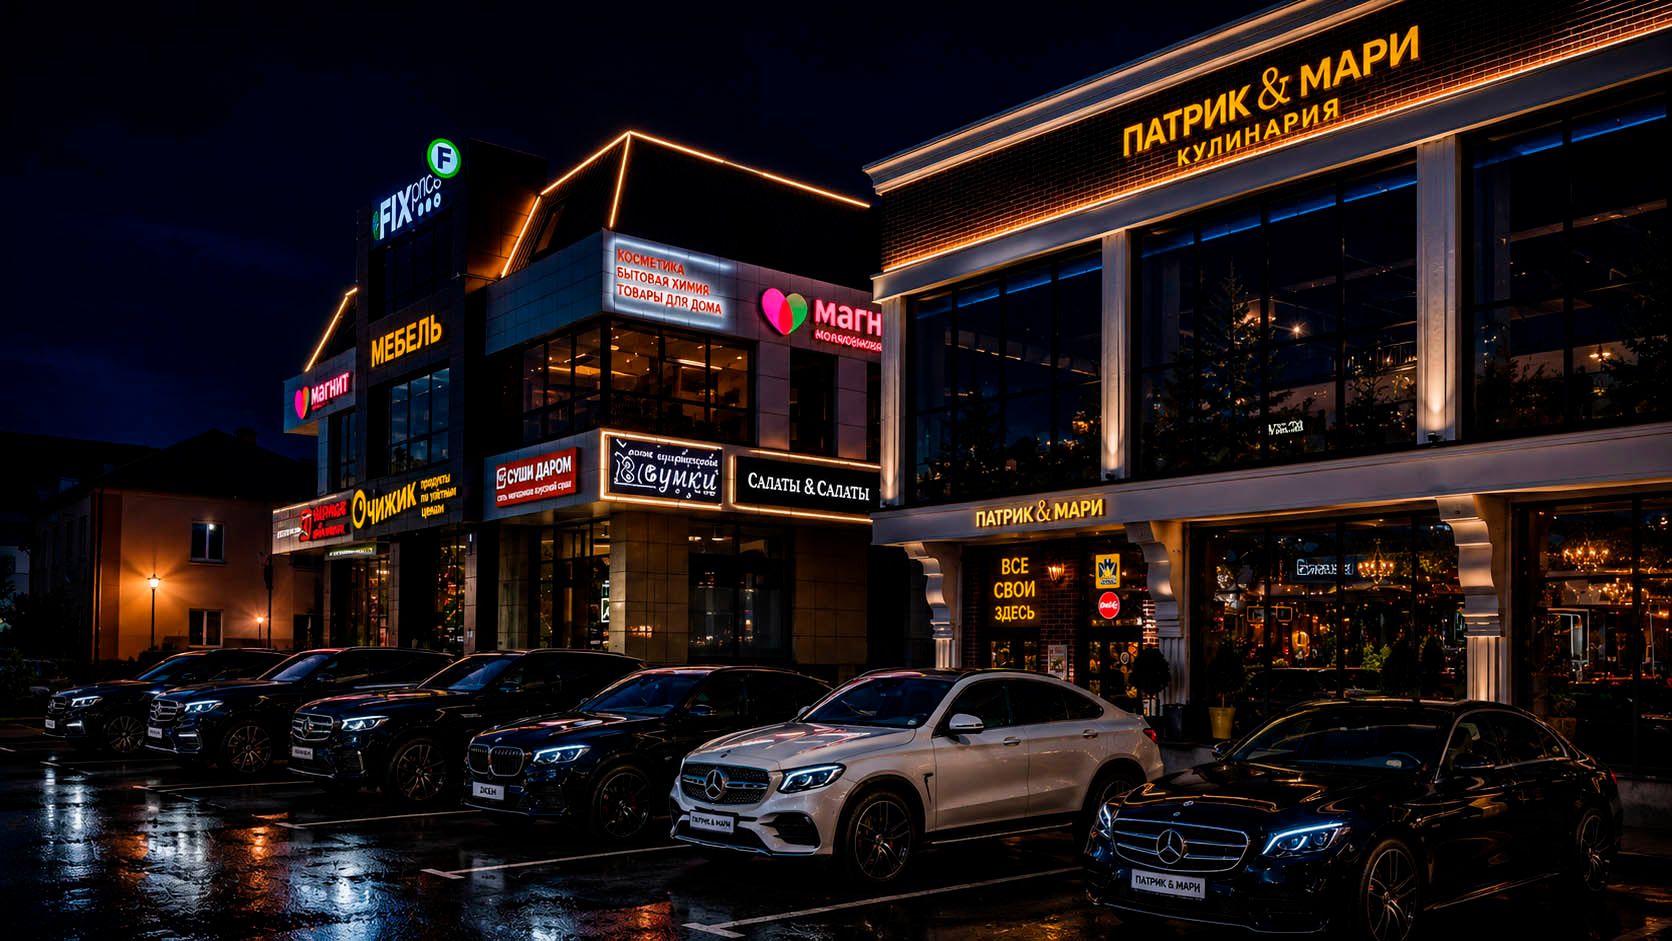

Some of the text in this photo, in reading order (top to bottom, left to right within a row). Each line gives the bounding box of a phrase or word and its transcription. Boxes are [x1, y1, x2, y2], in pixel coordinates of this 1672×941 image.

[1122, 25, 1420, 157] ПАТРИК & МАРИ
[1177, 97, 1340, 167] КУЛИНАРИЯ
[437, 145, 452, 169] F
[380, 184, 413, 240] FIX
[617, 248, 685, 275] КОСМЕТИКА
[617, 267, 710, 296] БЫТОВАЯ ХИМИЯ
[617, 284, 722, 315] ТОВАРЫ ДЛЯ ДОМА
[371, 313, 443, 368] МЕБЕЛЬ
[507, 455, 572, 485] СУШИ ДАРОМ
[804, 477, 816, 495] &
[976, 498, 1103, 528] ПАТРИК & МАРИ
[1001, 556, 1030, 576] ВСЕ
[993, 579, 1036, 599] СВОИ
[994, 604, 1036, 623] ЗДЕСЬ
[1136, 875, 1167, 887] ПАТРИК
[1176, 881, 1200, 893] МАРИ
